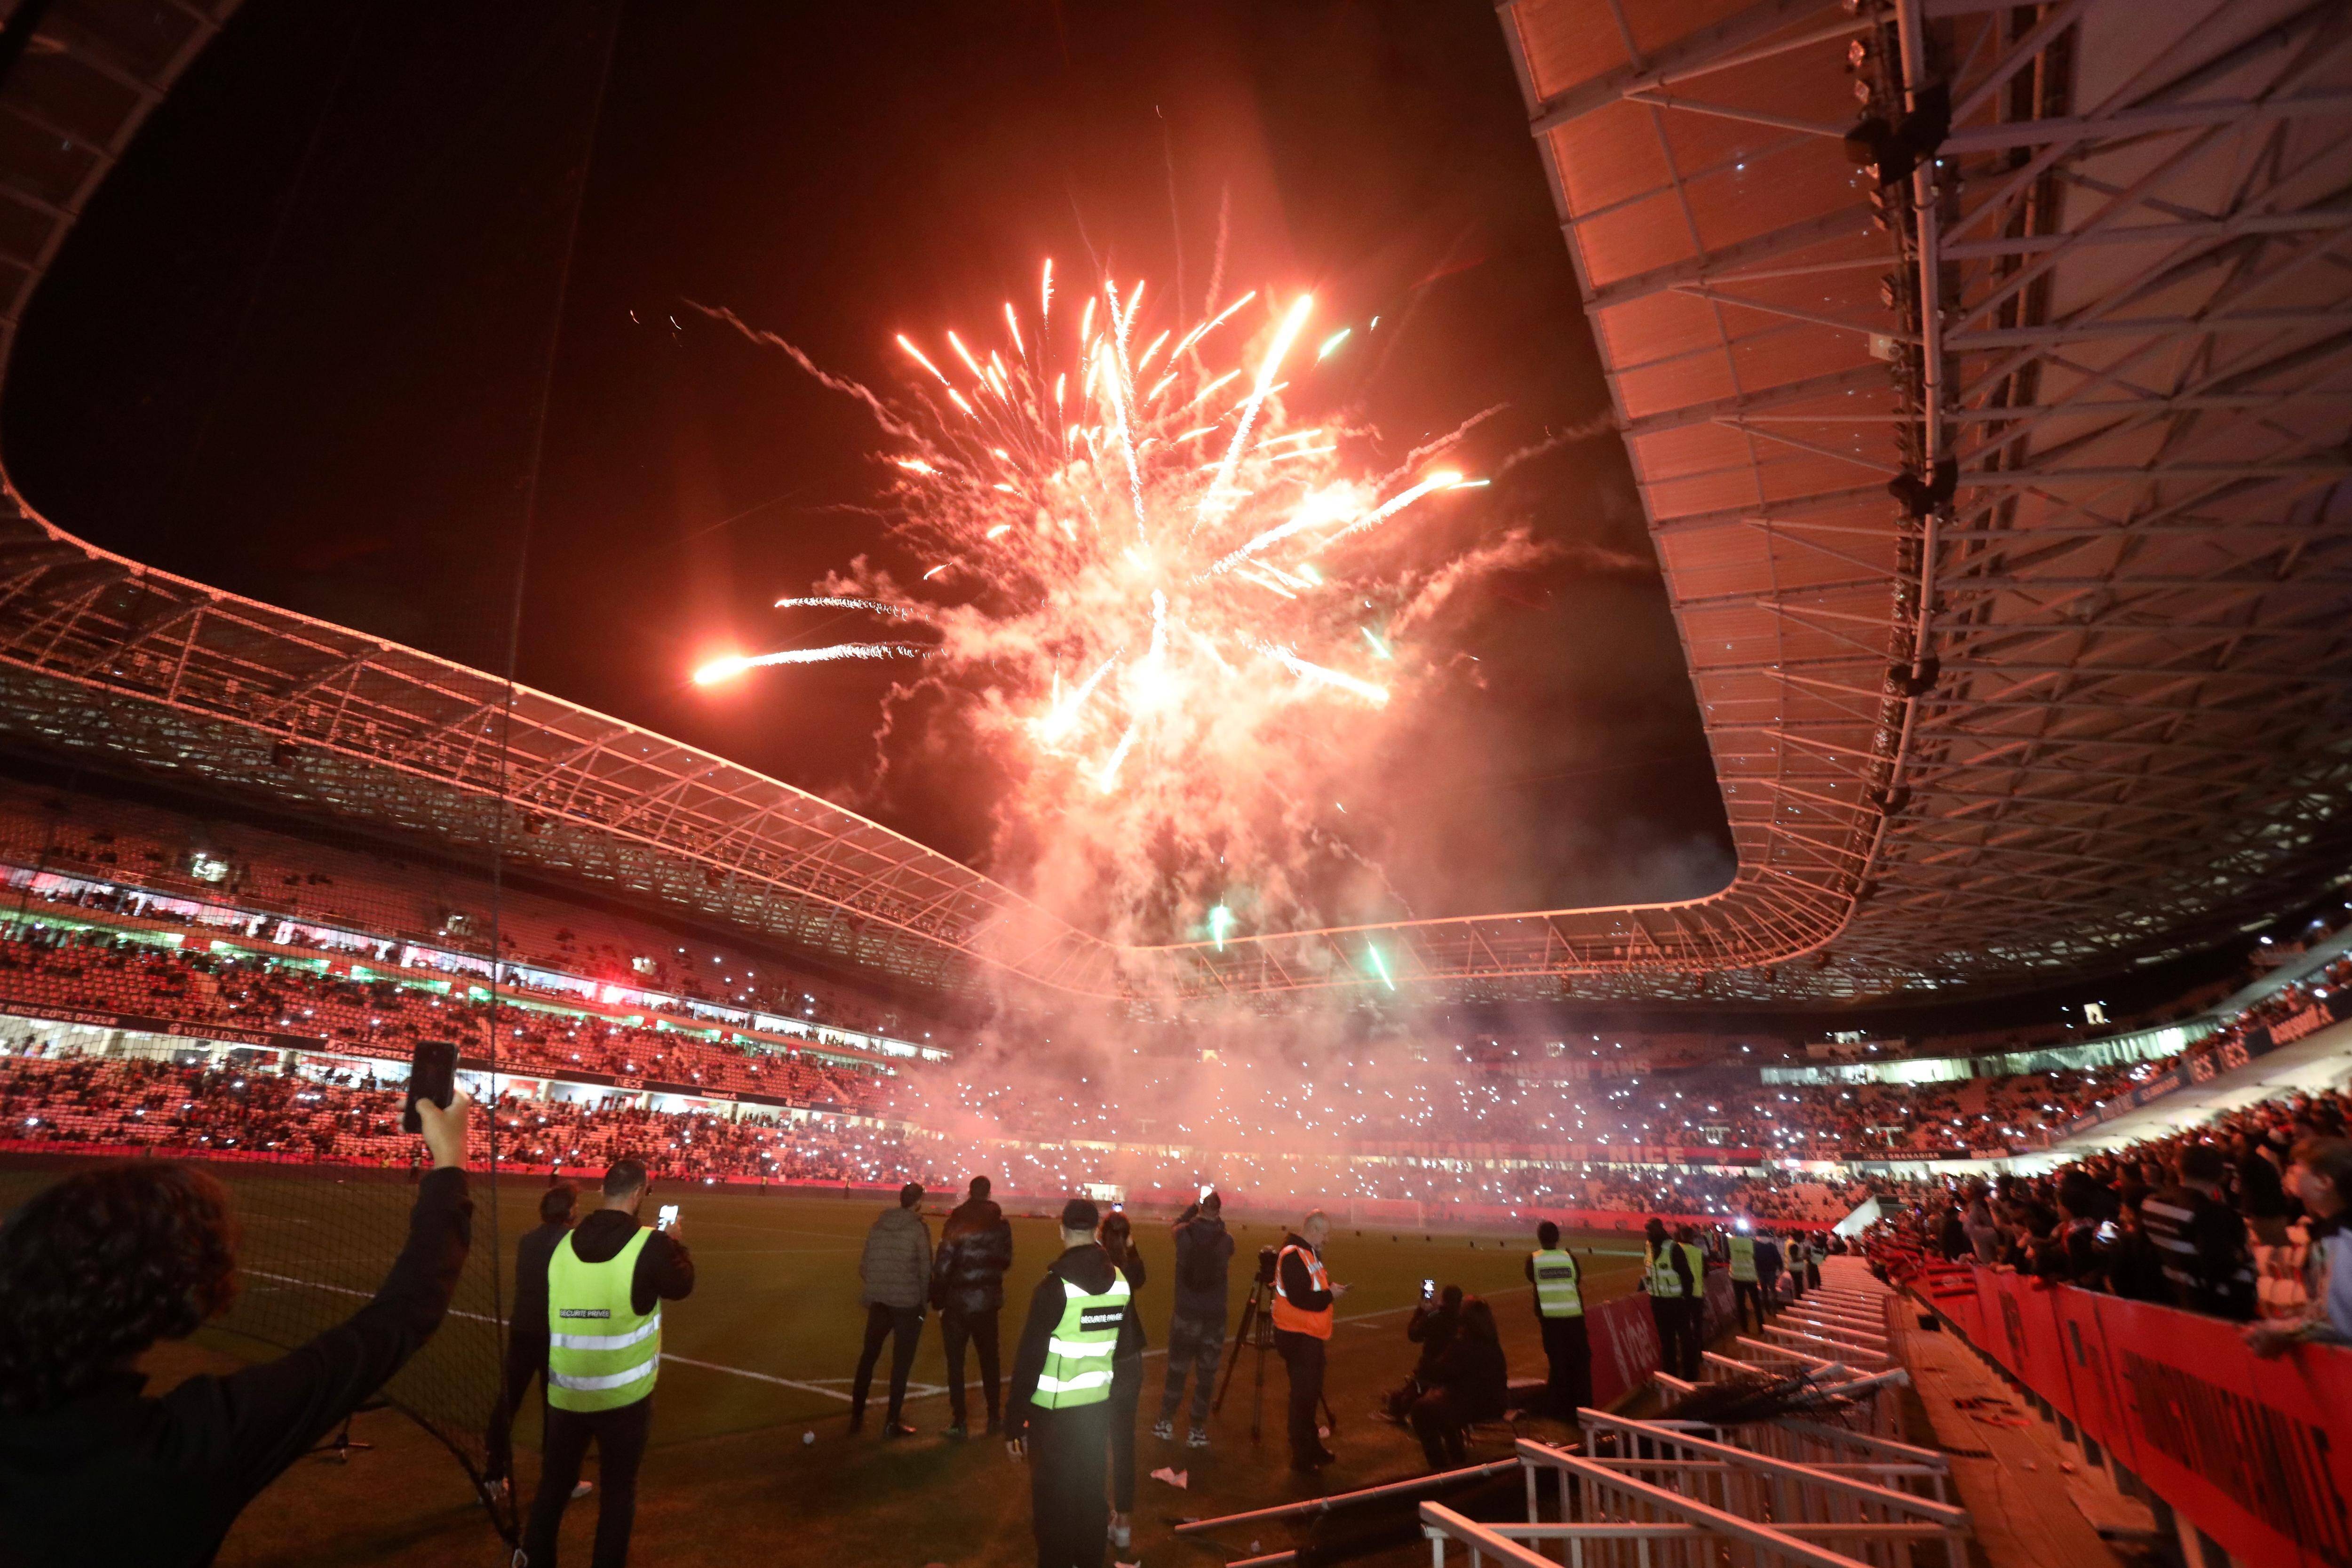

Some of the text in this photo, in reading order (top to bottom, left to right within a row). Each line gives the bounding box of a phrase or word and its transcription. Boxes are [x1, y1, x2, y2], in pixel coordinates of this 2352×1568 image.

[219, 1031, 238, 1041] DE
[241, 1033, 272, 1045] NICE
[1601, 1059, 1651, 1078] ANS
[842, 1106, 858, 1115] vbet
[1608, 1146, 1686, 1164] NICE
